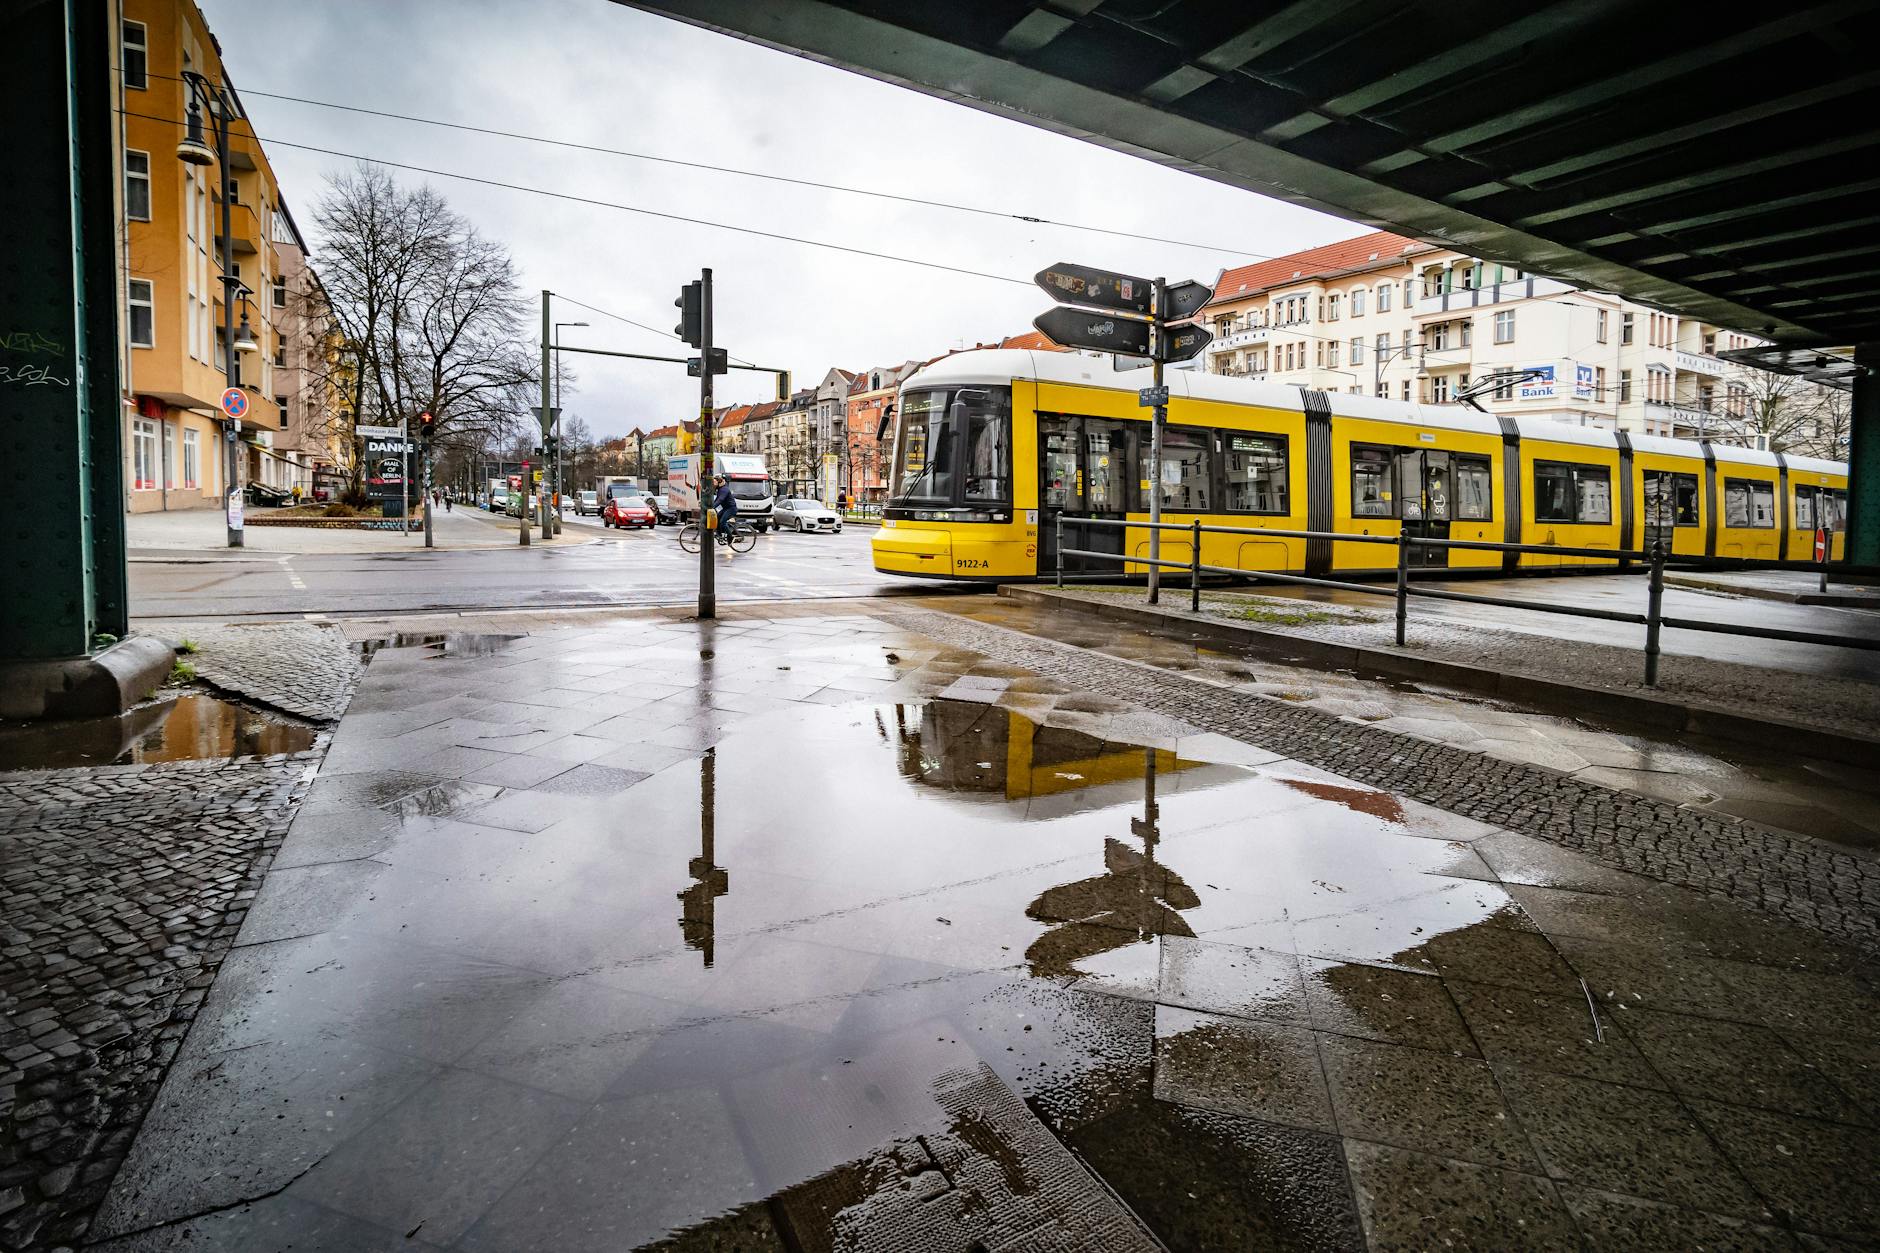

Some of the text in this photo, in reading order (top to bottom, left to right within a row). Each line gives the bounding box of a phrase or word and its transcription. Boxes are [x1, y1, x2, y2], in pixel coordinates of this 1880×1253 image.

[1522, 387, 1553, 397] Bank
[1576, 387, 1592, 397] Bank
[369, 442, 413, 453] DANKE
[957, 560, 989, 568] 9122-A
